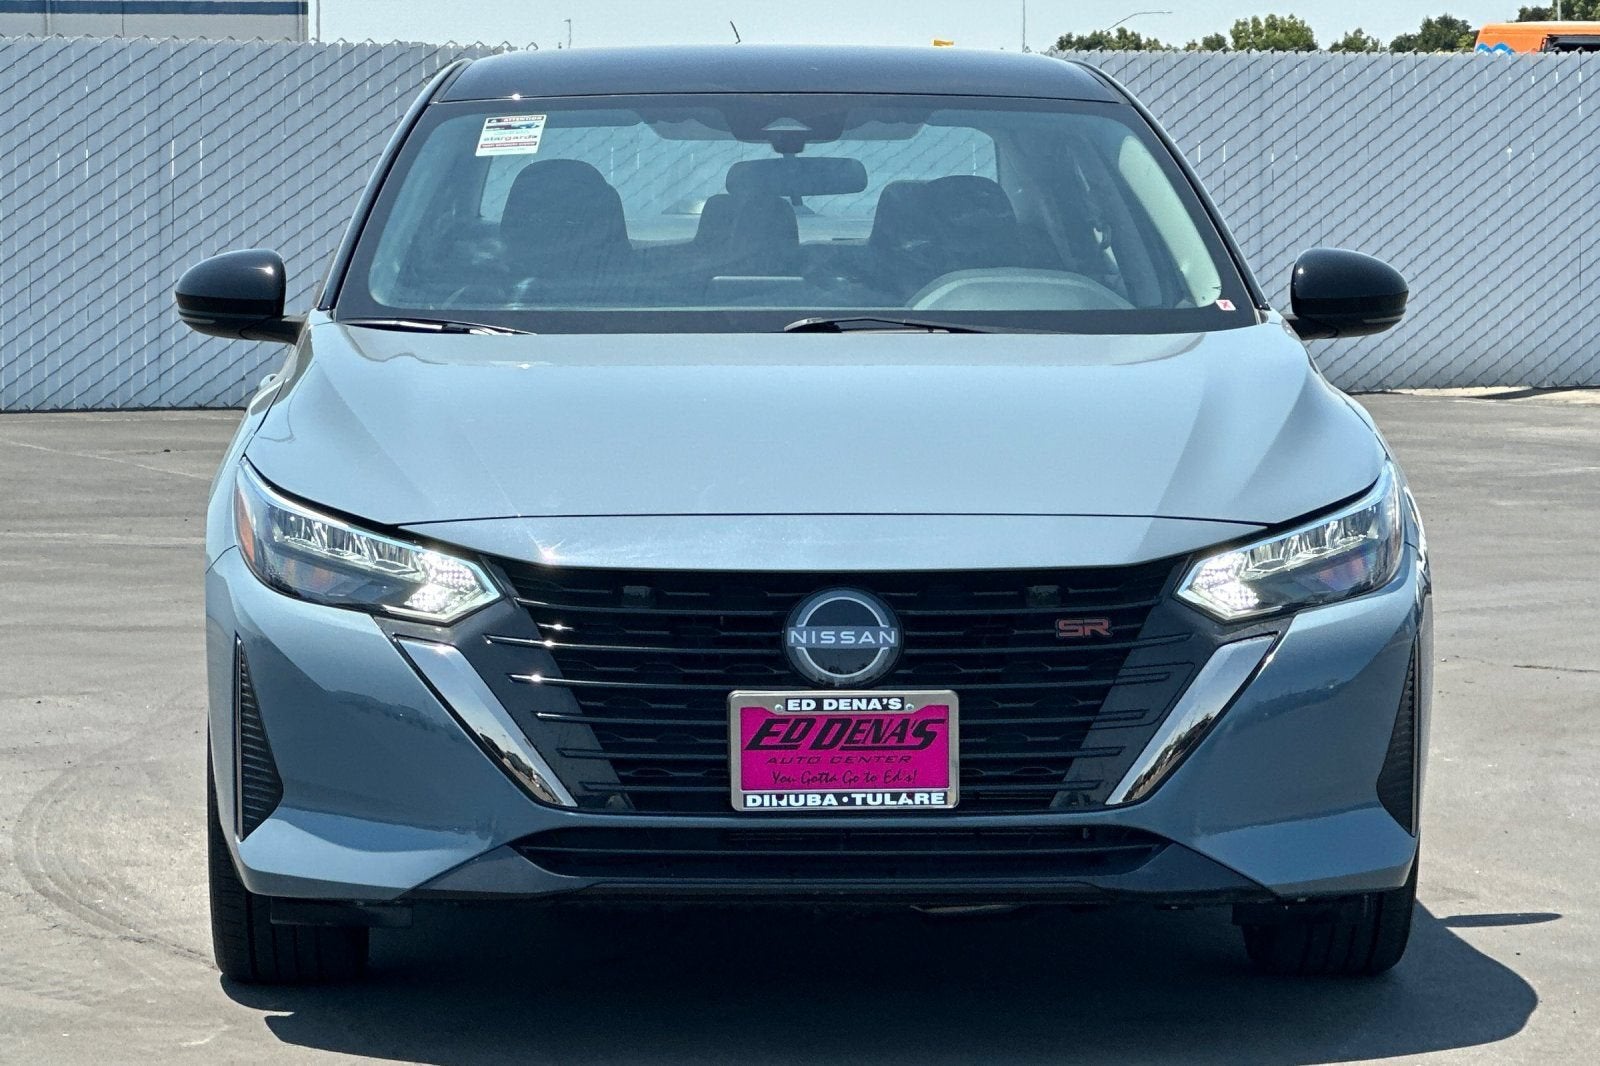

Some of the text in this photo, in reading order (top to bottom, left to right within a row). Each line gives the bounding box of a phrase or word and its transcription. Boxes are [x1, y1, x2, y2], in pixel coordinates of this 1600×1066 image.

[1057, 618, 1111, 639] SR
[790, 630, 895, 644] NISSAN
[787, 697, 902, 711] ED DENA'S
[745, 718, 947, 751] ED DENA'S
[766, 755, 913, 765] AUTO CENTER
[772, 771, 796, 784] You
[800, 770, 838, 786] Gotta
[842, 770, 859, 786] Go
[863, 770, 877, 784] to
[746, 792, 945, 807] DINUBA TULARE
